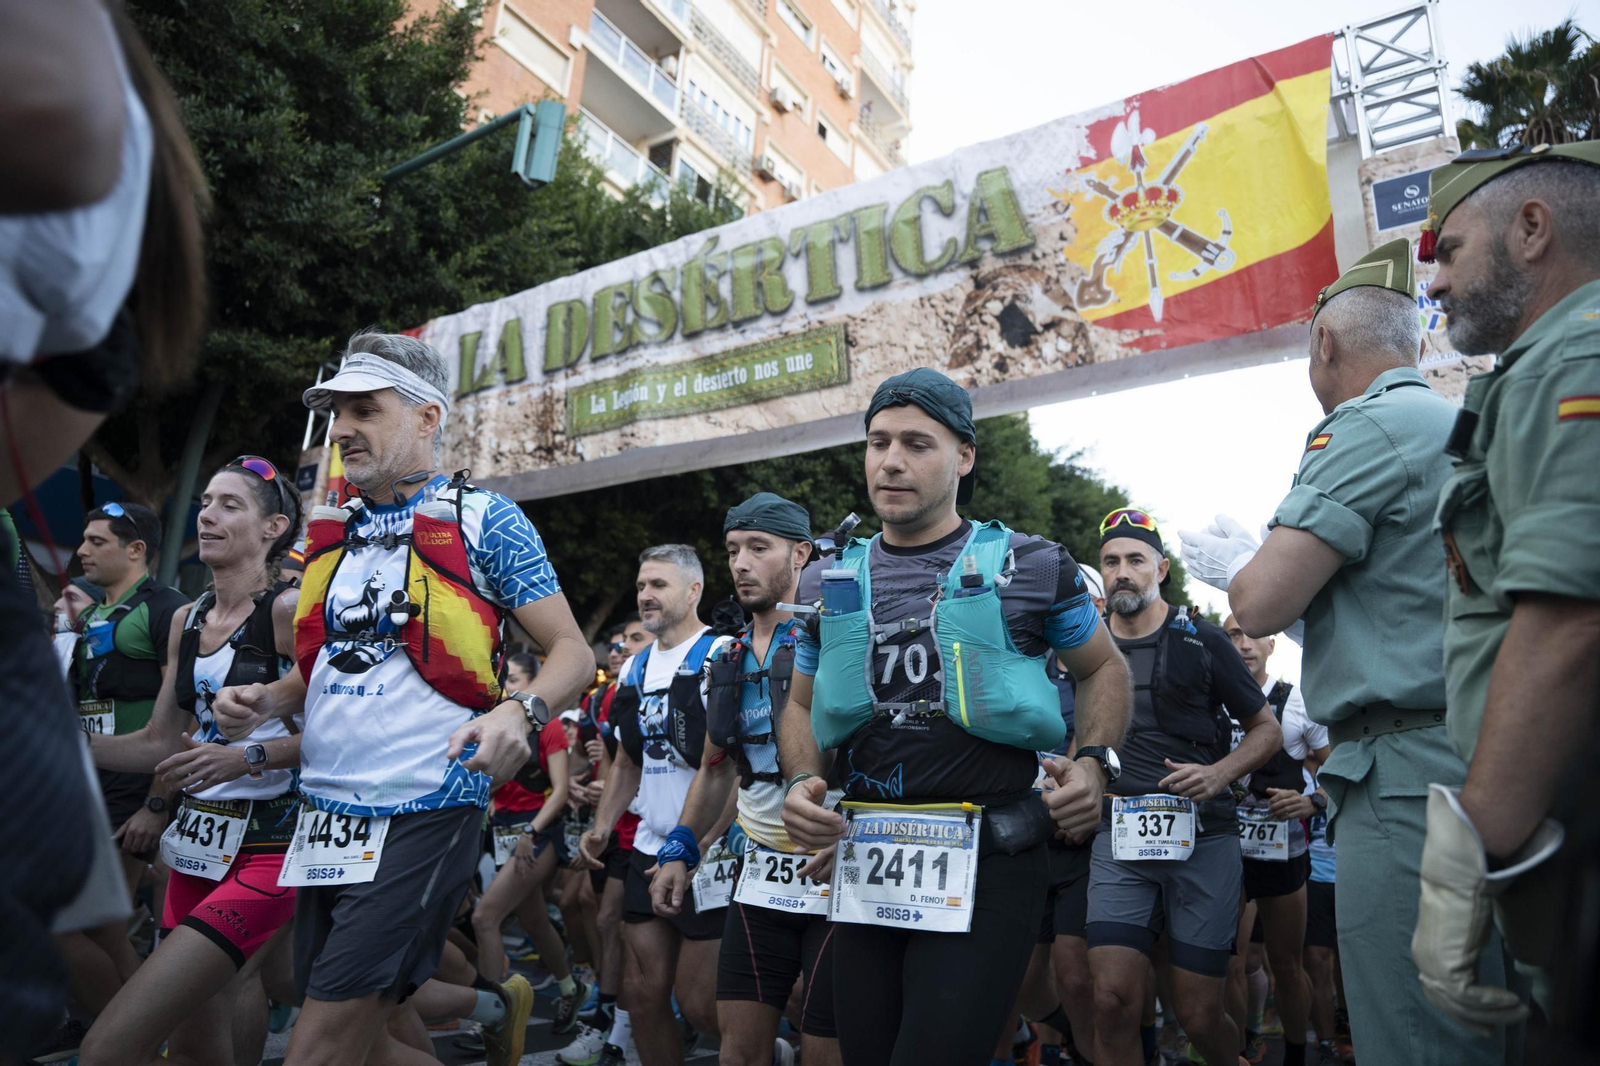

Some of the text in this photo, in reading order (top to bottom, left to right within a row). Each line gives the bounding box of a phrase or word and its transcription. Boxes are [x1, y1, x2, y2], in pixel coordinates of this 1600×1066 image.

[1391, 196, 1428, 212] SENATO
[455, 164, 1036, 400] LA DESÉRTICA
[590, 352, 813, 414] La Legión y el desierto nos une
[430, 531, 453, 539] ULTRA
[330, 683, 355, 696] duros
[376, 683, 384, 696] 2
[177, 812, 230, 850] 4431
[307, 808, 372, 849] 4434
[863, 821, 879, 835] LA
[881, 819, 965, 840] DESÉRTICA
[1138, 814, 1176, 837] 337
[1239, 821, 1278, 841] 2767
[1138, 848, 1162, 856] asisa
[175, 857, 200, 871] asisa
[765, 856, 821, 887] 251
[866, 847, 949, 891] 2411
[306, 867, 336, 880] asisa
[768, 896, 799, 909] asisa
[920, 895, 946, 905] FENOY
[876, 906, 911, 922] asisa
